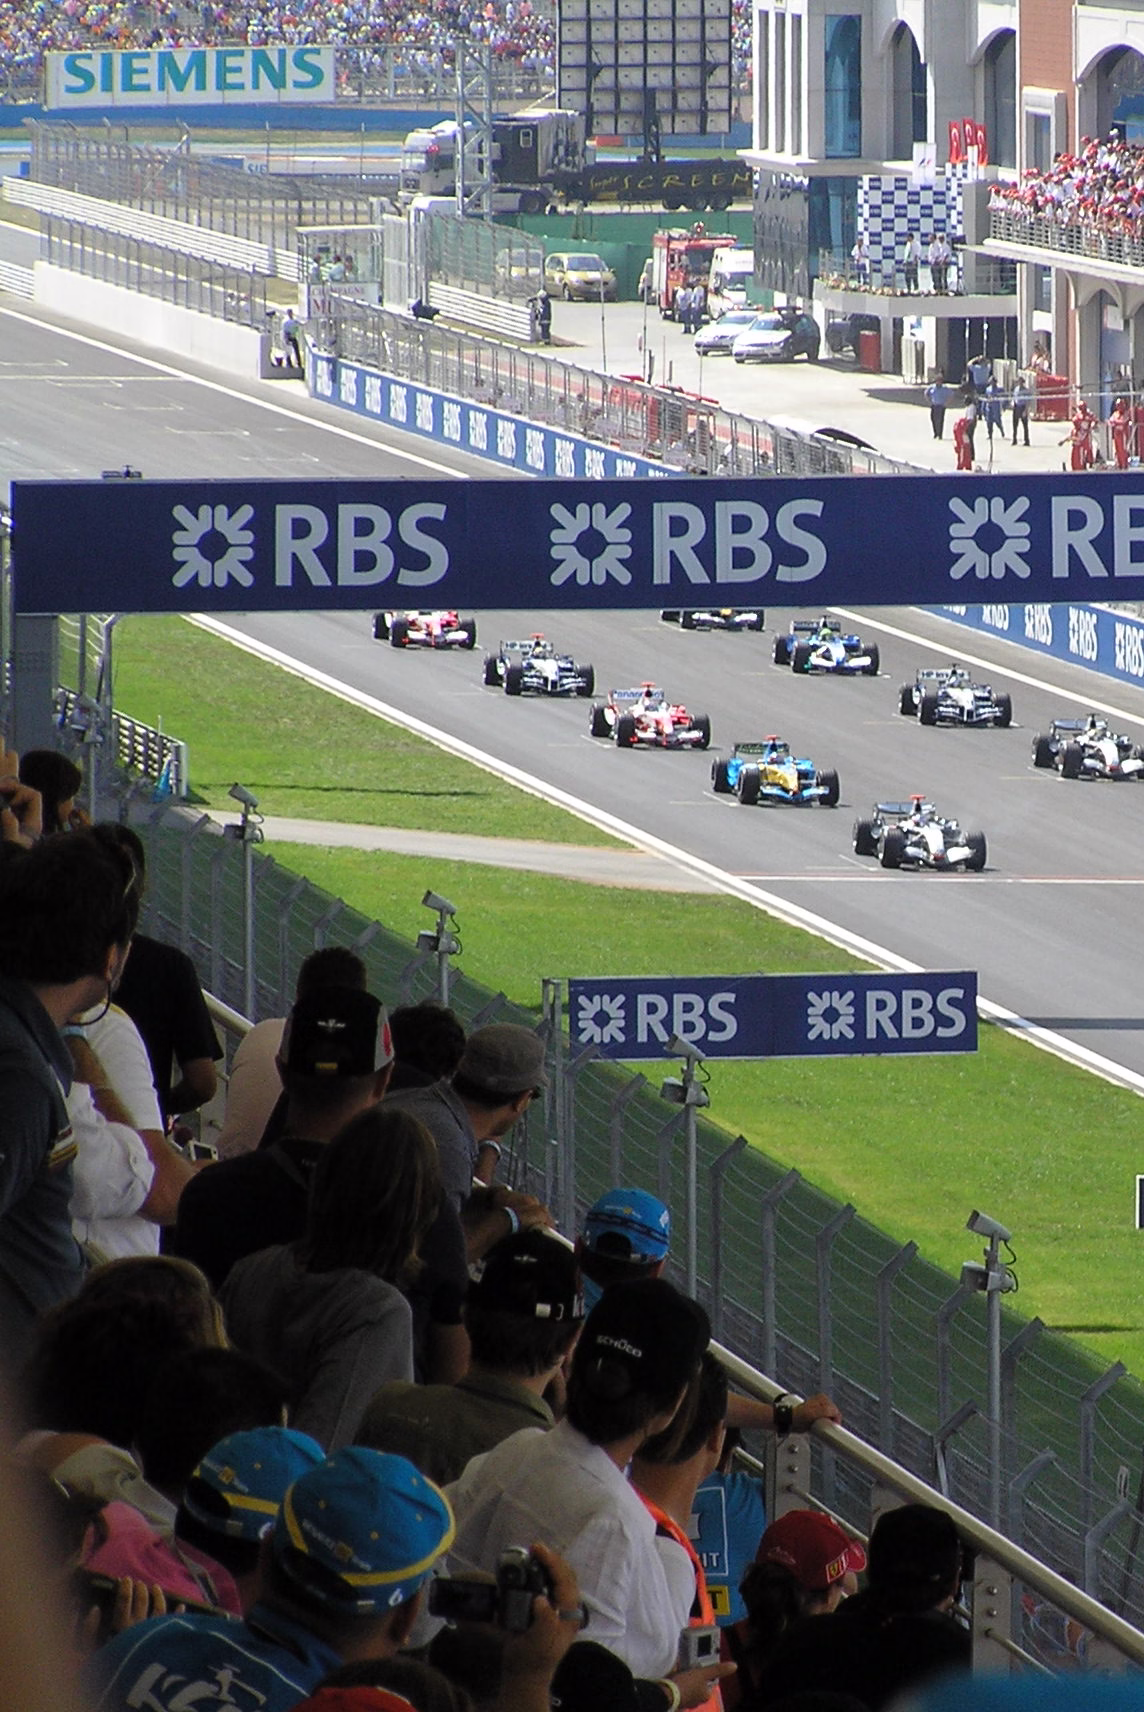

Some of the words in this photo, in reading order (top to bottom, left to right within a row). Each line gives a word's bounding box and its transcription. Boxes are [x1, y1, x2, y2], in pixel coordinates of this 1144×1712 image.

[63, 47, 324, 94] SIEMENS
[275, 504, 449, 586] RBS
[653, 501, 827, 585] RBS
[1079, 609, 1098, 662] RBS
[1125, 624, 1144, 678] RBS
[637, 993, 738, 1043] RBS
[866, 988, 967, 1040] RBS
